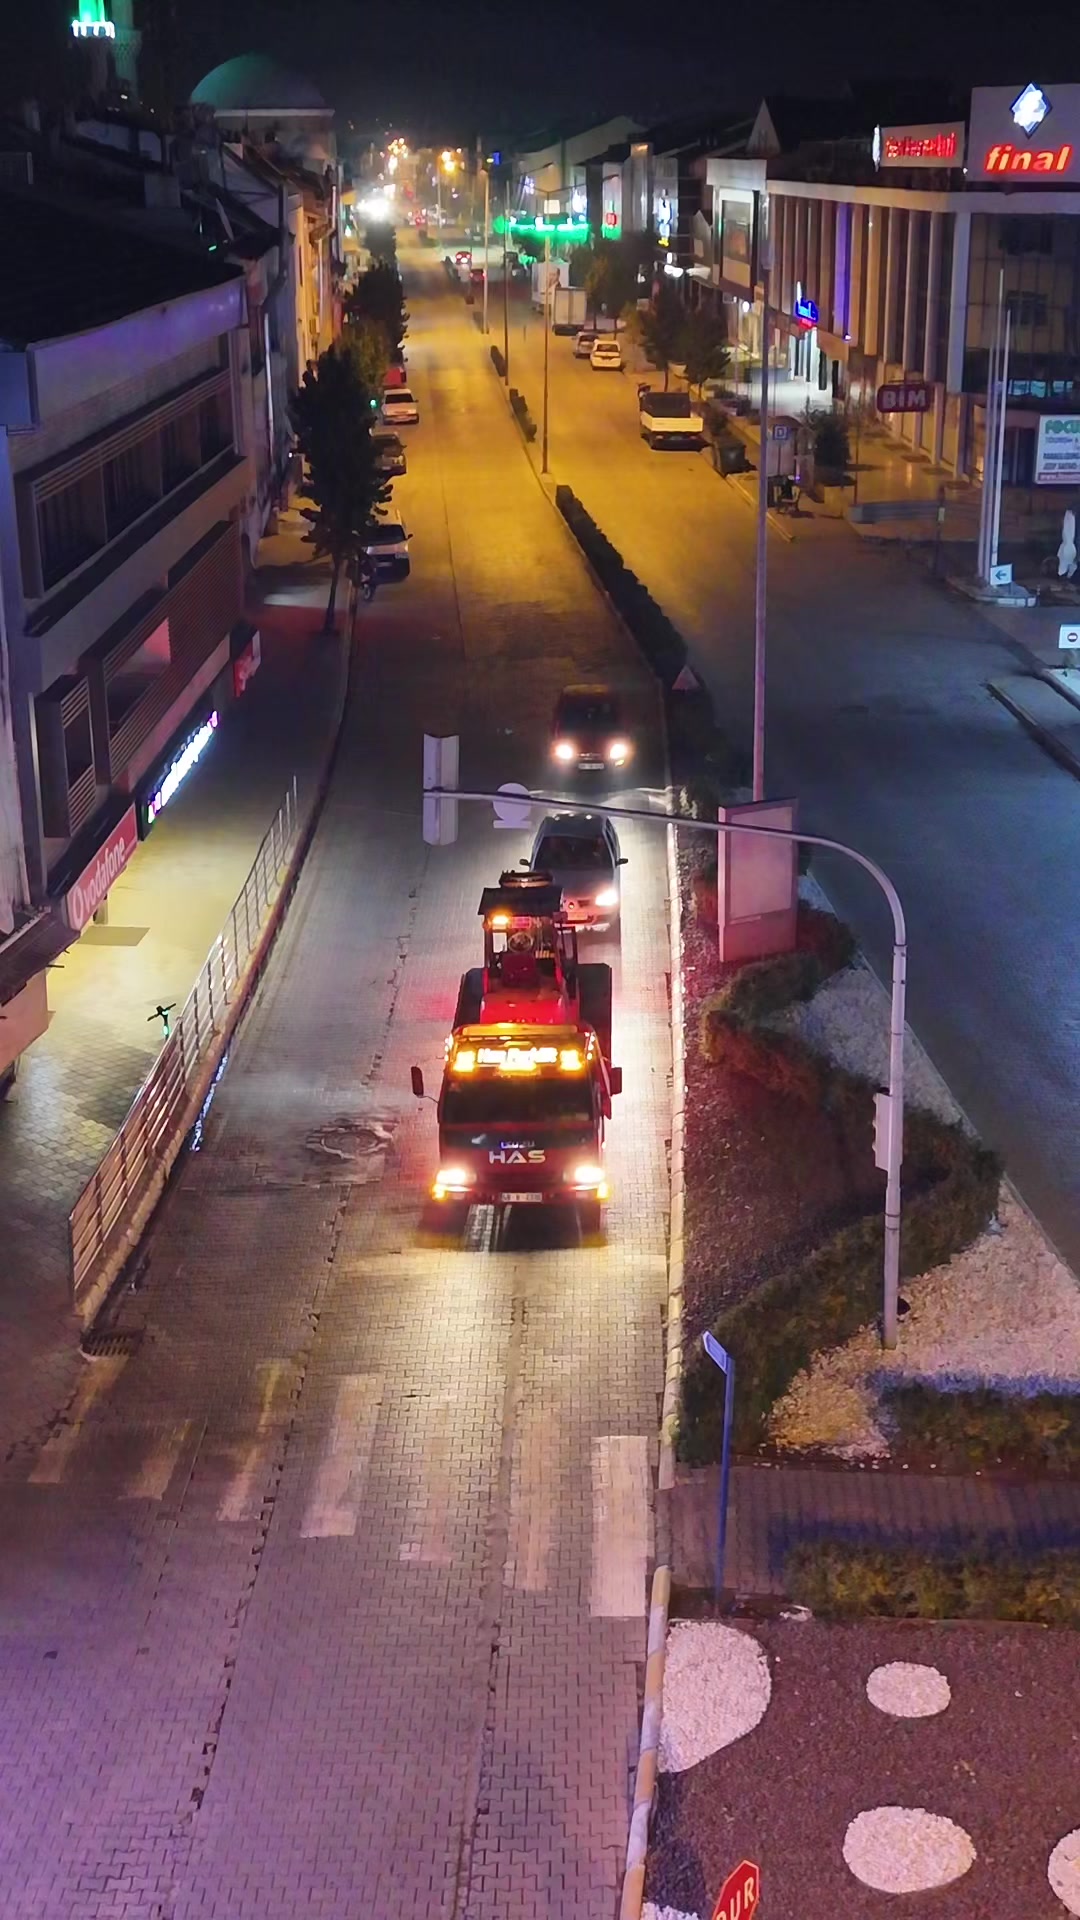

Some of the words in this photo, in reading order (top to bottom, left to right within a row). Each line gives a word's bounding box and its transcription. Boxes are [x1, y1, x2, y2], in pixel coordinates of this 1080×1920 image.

[986, 145, 1071, 171] final
[83, 837, 125, 913] vodafone
[488, 1149, 546, 1164] HAS
